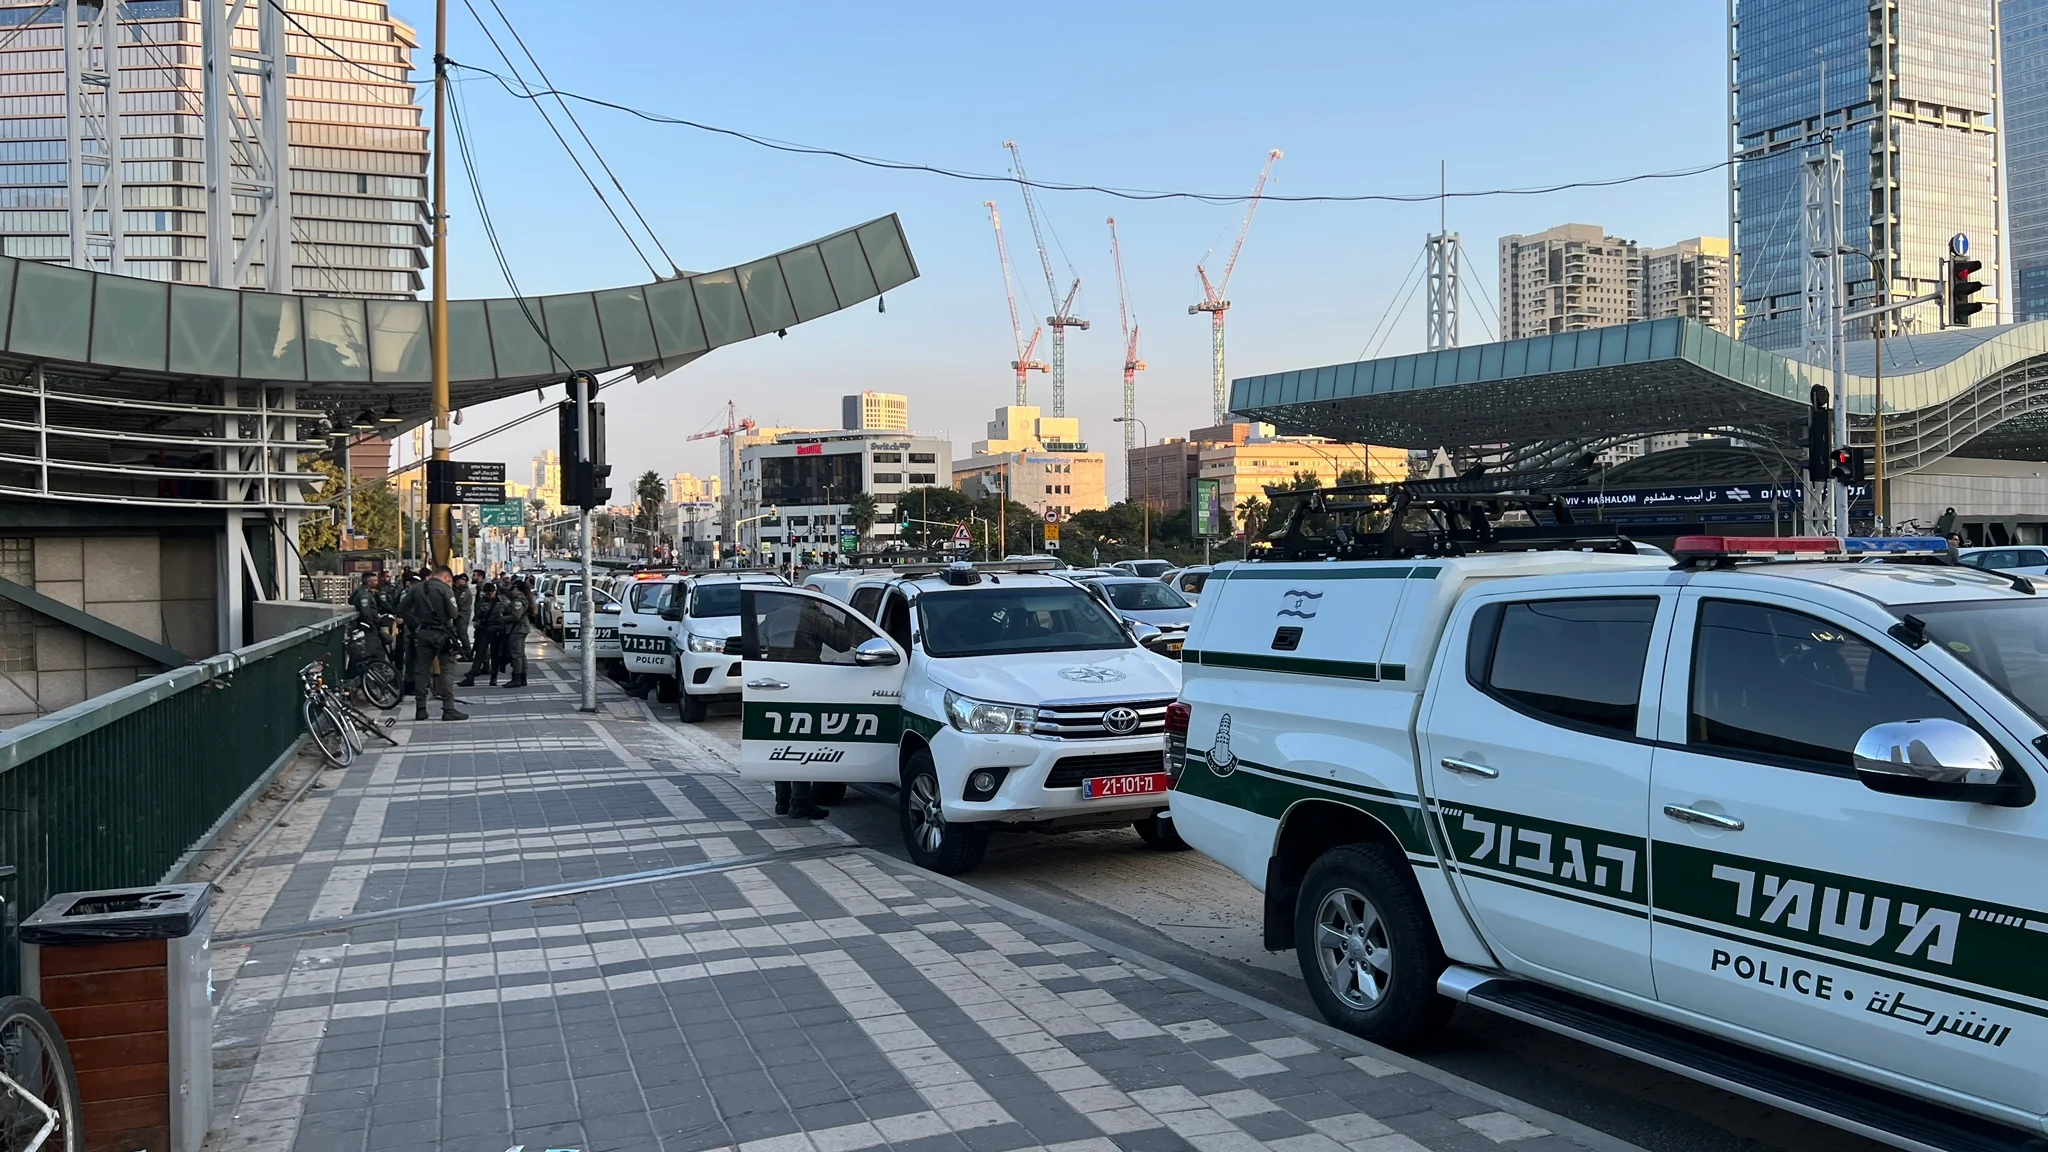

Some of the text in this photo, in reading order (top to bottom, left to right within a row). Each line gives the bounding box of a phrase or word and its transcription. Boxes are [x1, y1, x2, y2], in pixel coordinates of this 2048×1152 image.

[1565, 497, 1579, 505] VIV
[1587, 495, 1636, 504] HASHALOM
[1683, 489, 1704, 503] أبيب
[1705, 490, 1717, 502] تل
[570, 628, 612, 639] משר
[623, 635, 666, 651] הגבול
[635, 655, 665, 665] POLICE
[764, 711, 879, 736] משמר
[768, 745, 845, 765] الشرطة
[1461, 812, 1962, 966] משמר הגבול
[1710, 948, 1834, 1001] POLICE
[1864, 991, 2012, 1048] الشرطة
